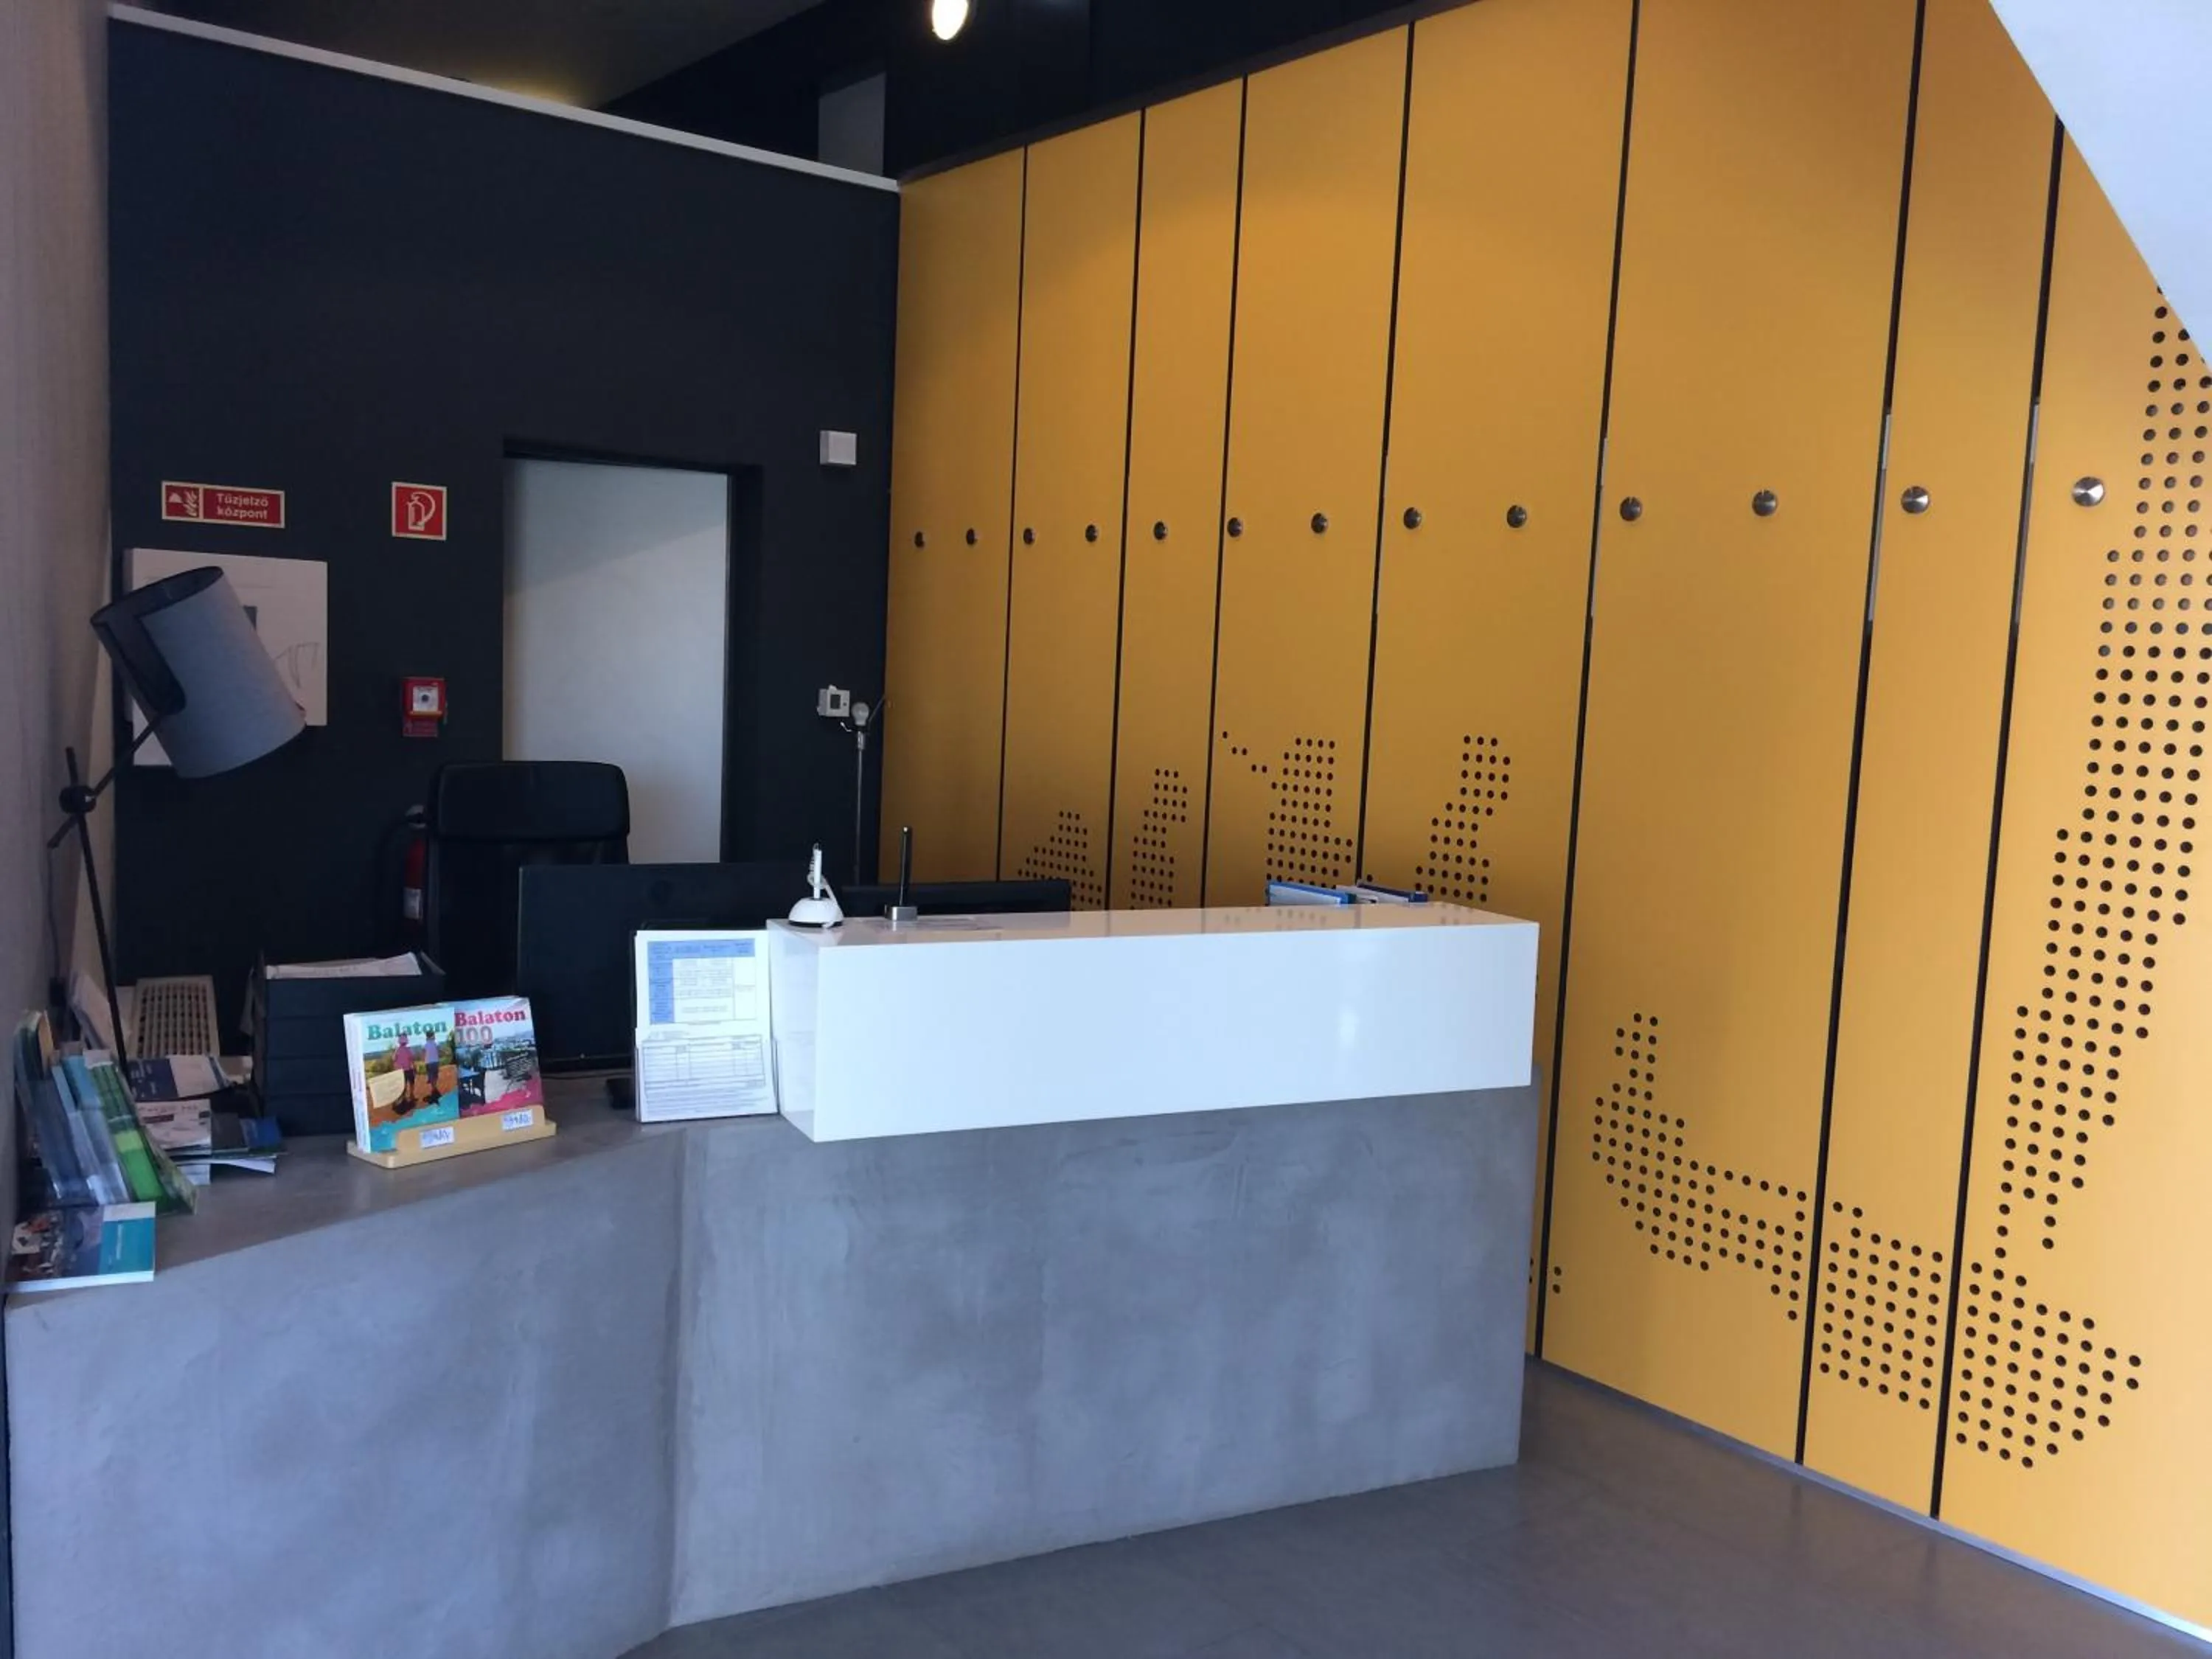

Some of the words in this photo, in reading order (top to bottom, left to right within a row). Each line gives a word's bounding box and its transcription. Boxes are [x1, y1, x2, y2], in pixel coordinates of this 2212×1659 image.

[217, 505, 268, 519] központ
[454, 1009, 526, 1026] Balaton
[367, 1020, 447, 1040] Balaton
[455, 1025, 493, 1045] 100
